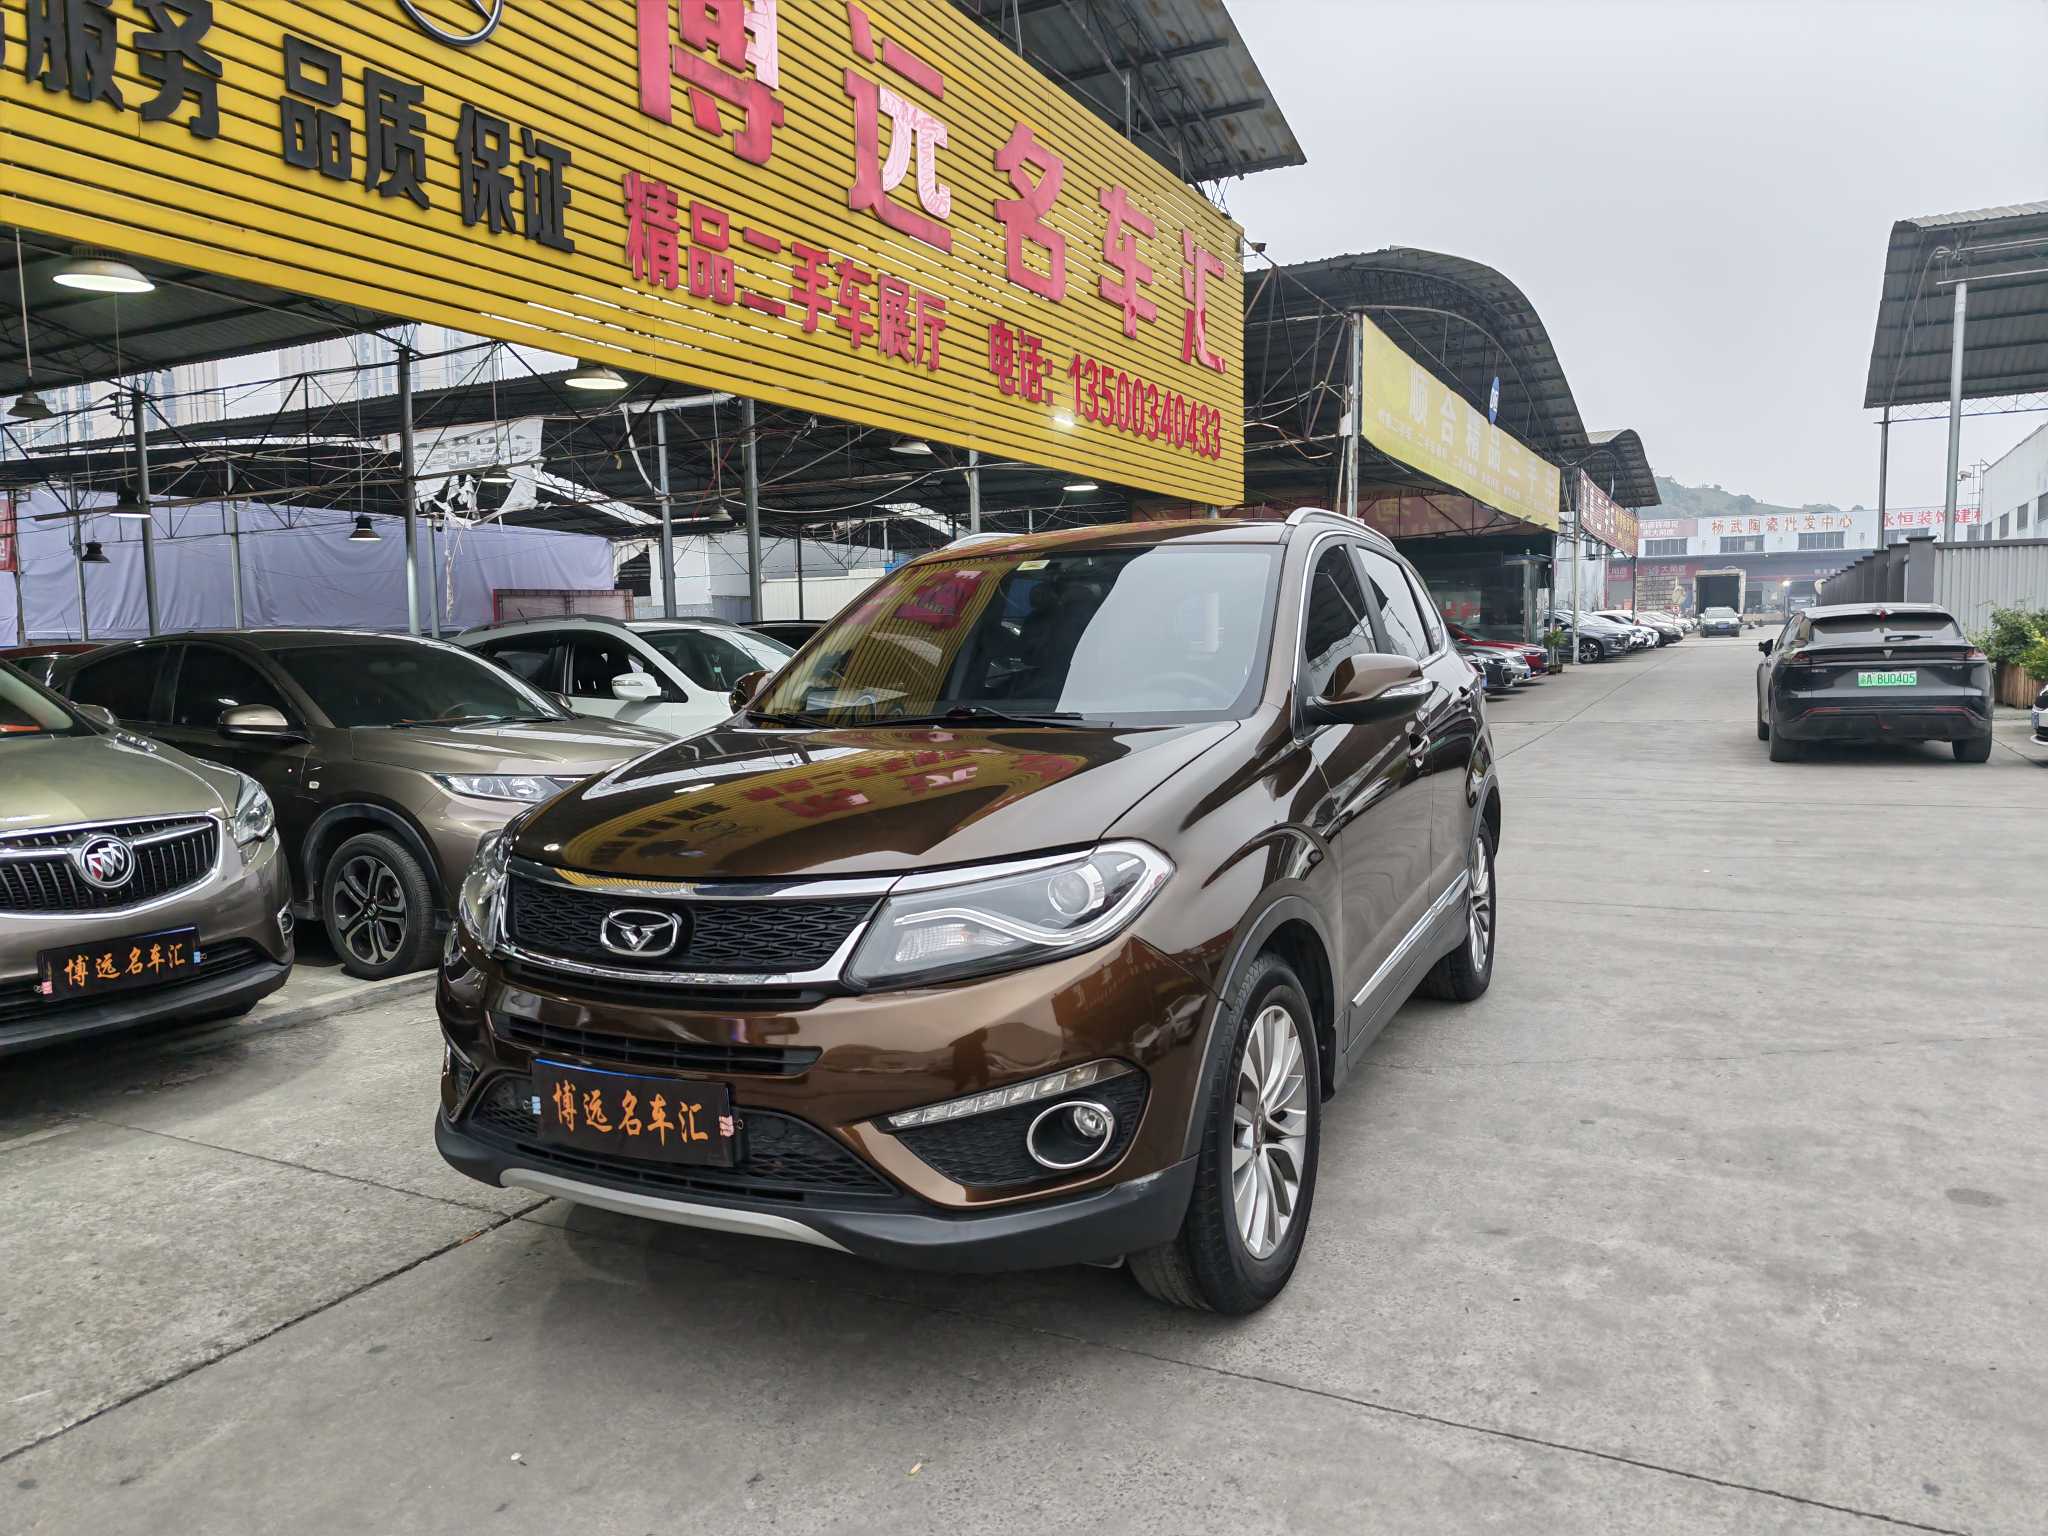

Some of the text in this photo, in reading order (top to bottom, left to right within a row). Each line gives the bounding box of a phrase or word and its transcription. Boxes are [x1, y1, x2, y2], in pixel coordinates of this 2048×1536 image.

[0, 0, 576, 254] 服务 品质保证
[623, 170, 946, 372] 精品二手车展厅
[988, 319, 1222, 461] 电话: 13500340433
[1711, 514, 1853, 535] 杨武陶瓷批发中心
[64, 943, 186, 988] 博远名车汇
[552, 1079, 709, 1147] 博远名车汇
